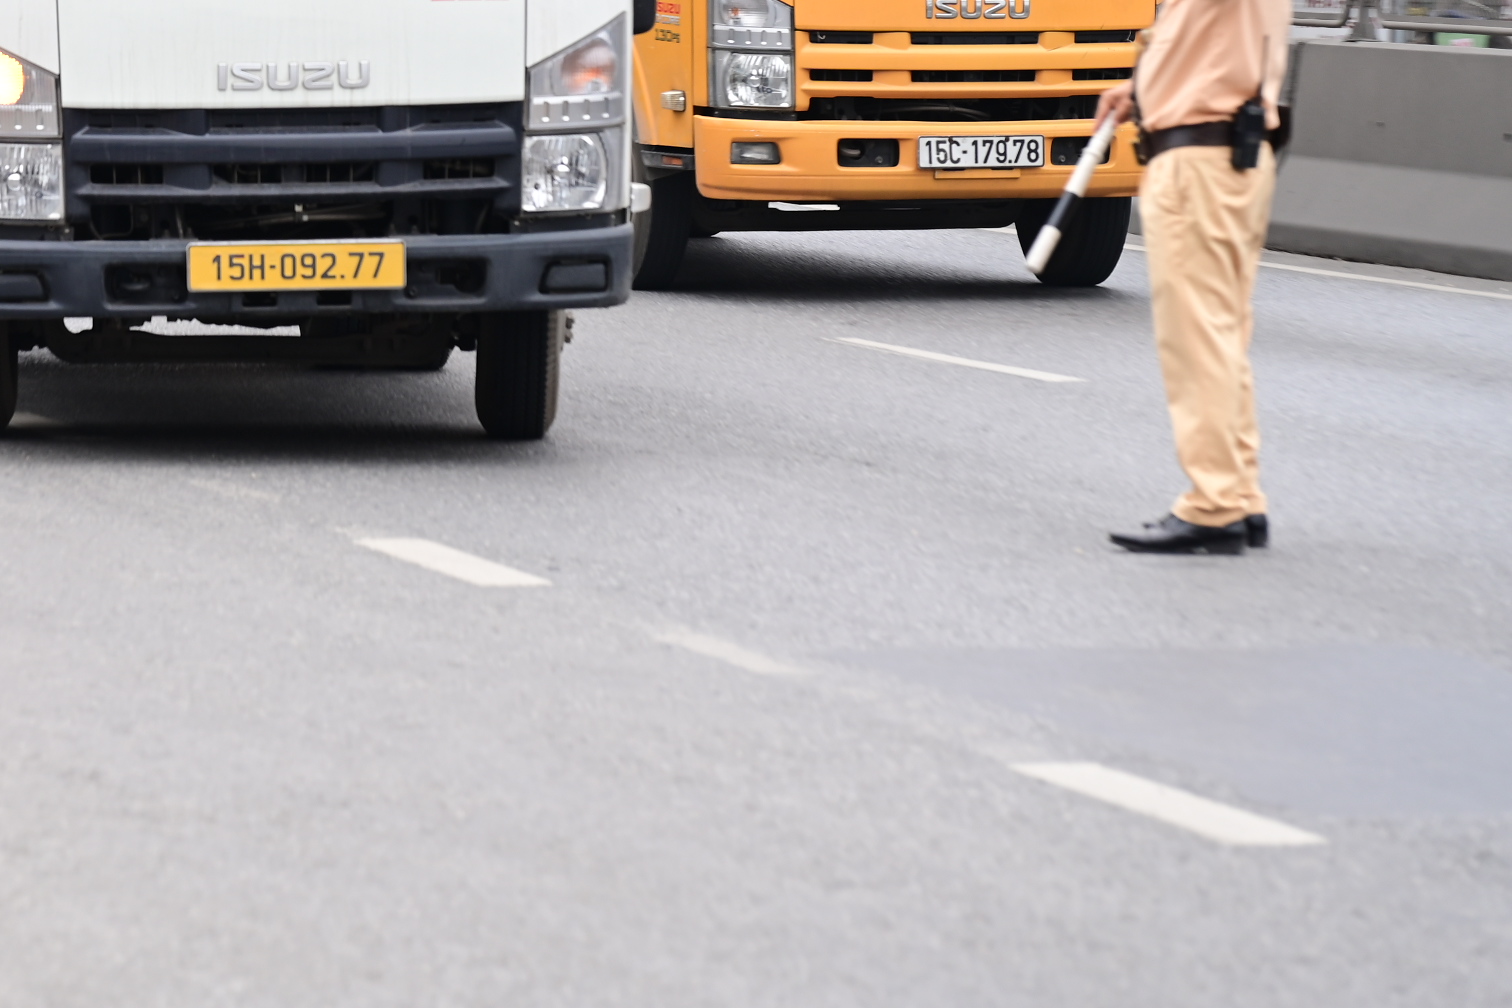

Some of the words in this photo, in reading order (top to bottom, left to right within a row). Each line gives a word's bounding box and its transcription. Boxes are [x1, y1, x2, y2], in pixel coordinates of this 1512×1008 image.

[656, 1, 681, 14] SUZU
[217, 60, 371, 91] ISUZU
[925, 139, 1040, 165] 15C-179.78
[212, 252, 385, 281] 15H-092.77
